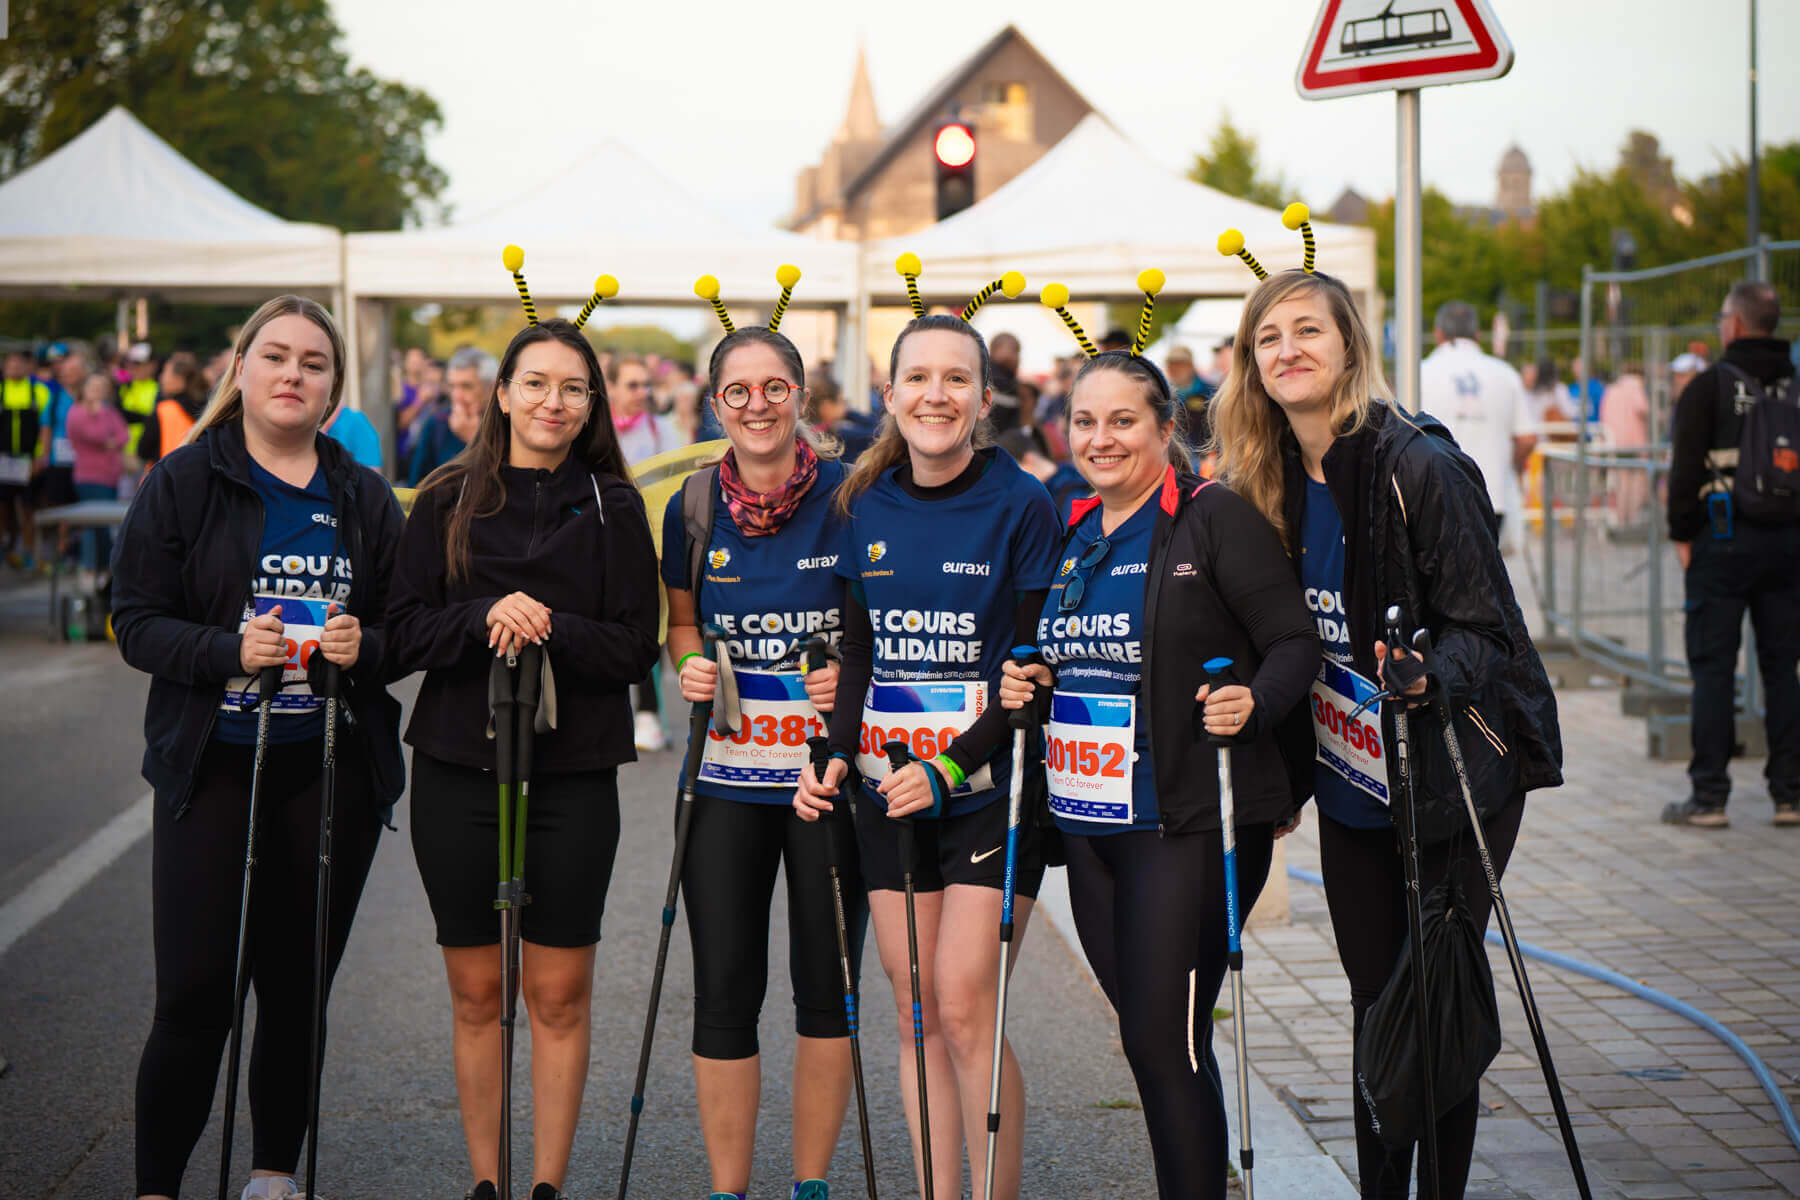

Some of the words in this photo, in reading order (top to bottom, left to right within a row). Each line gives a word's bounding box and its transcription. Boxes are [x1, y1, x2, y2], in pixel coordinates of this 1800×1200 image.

[942, 561, 991, 576] euraxi
[741, 608, 841, 635] COURS
[884, 609, 976, 636] COURS
[1052, 613, 1131, 638] COURS
[1313, 692, 1382, 759] 30156
[725, 746, 748, 758] Team
[750, 748, 766, 758] OC
[768, 750, 803, 759] forever
[1047, 734, 1126, 778] 30152
[1076, 778, 1104, 790] forever
